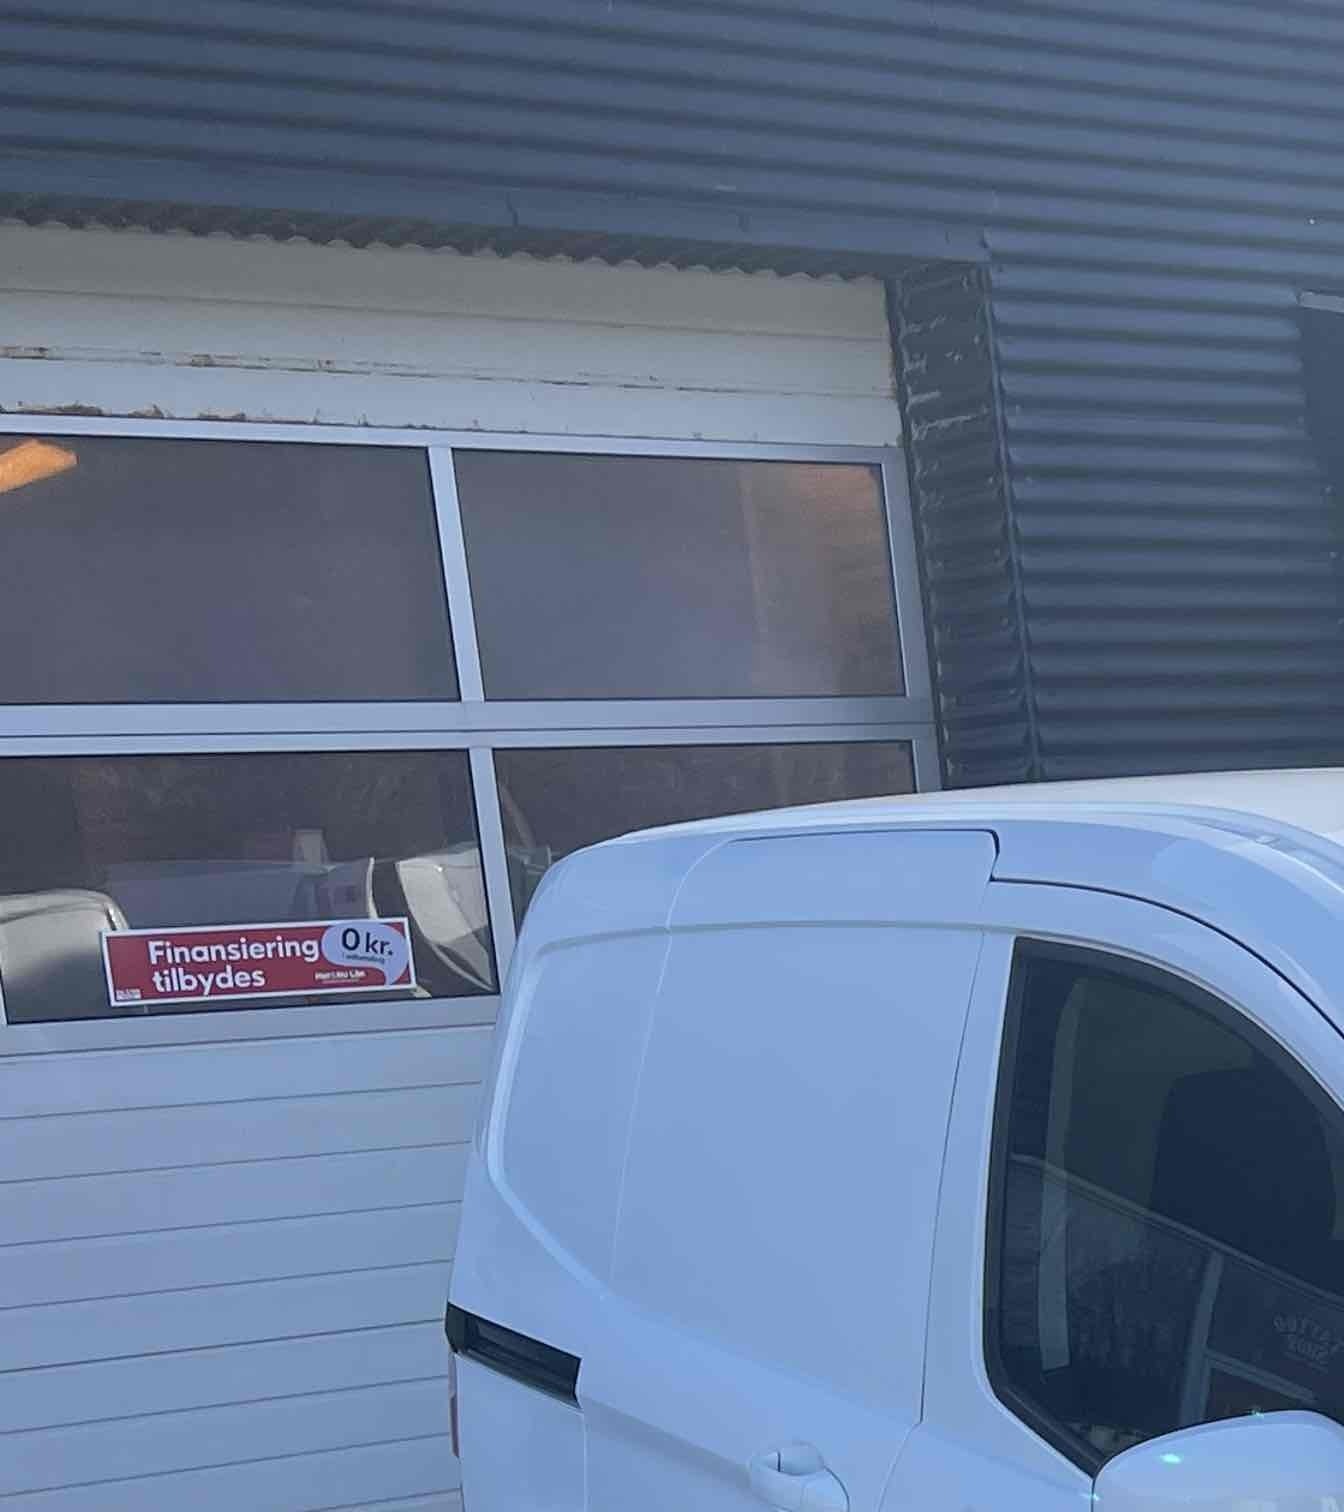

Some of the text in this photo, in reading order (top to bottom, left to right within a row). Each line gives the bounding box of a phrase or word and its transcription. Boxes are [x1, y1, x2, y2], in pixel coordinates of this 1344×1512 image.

[147, 936, 319, 965] Finansiering
[341, 927, 394, 956] 0 kr.
[152, 966, 266, 996] tilbydes
